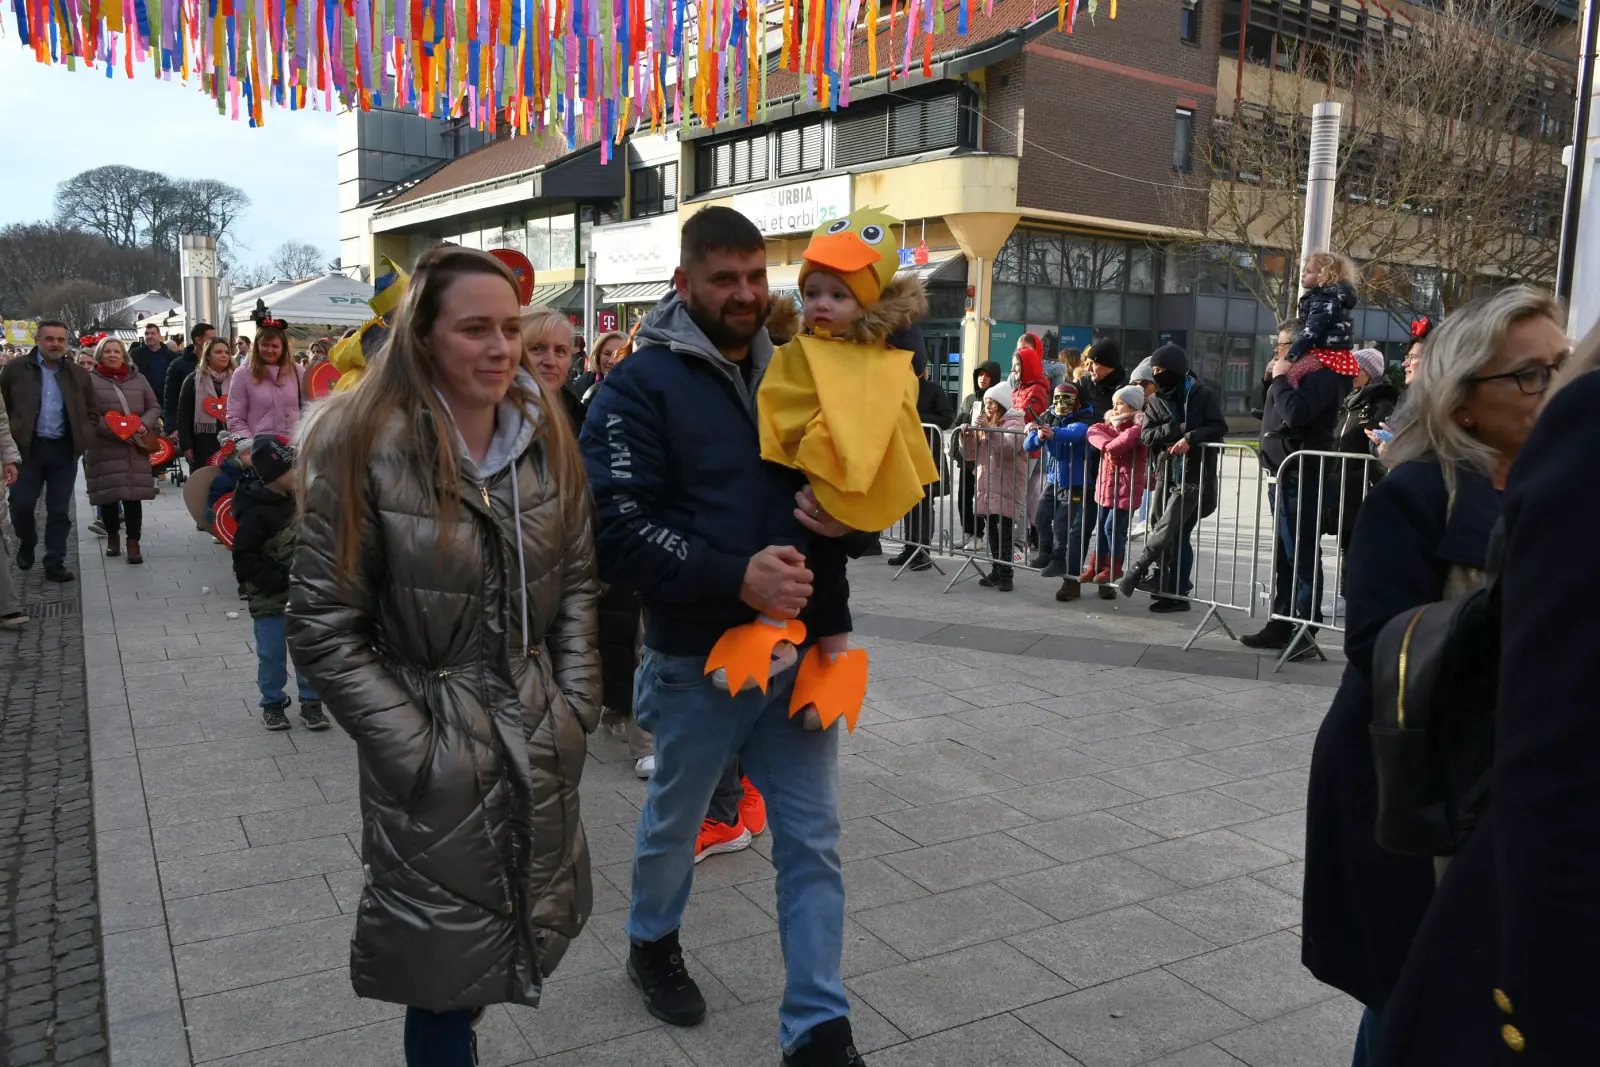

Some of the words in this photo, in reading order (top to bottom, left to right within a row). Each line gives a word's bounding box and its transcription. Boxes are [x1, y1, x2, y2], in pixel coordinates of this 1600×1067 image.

[778, 185, 813, 207] URBIA
[771, 213, 784, 230] et
[819, 205, 837, 225] 25
[328, 296, 369, 305] PA
[603, 315, 615, 331] T
